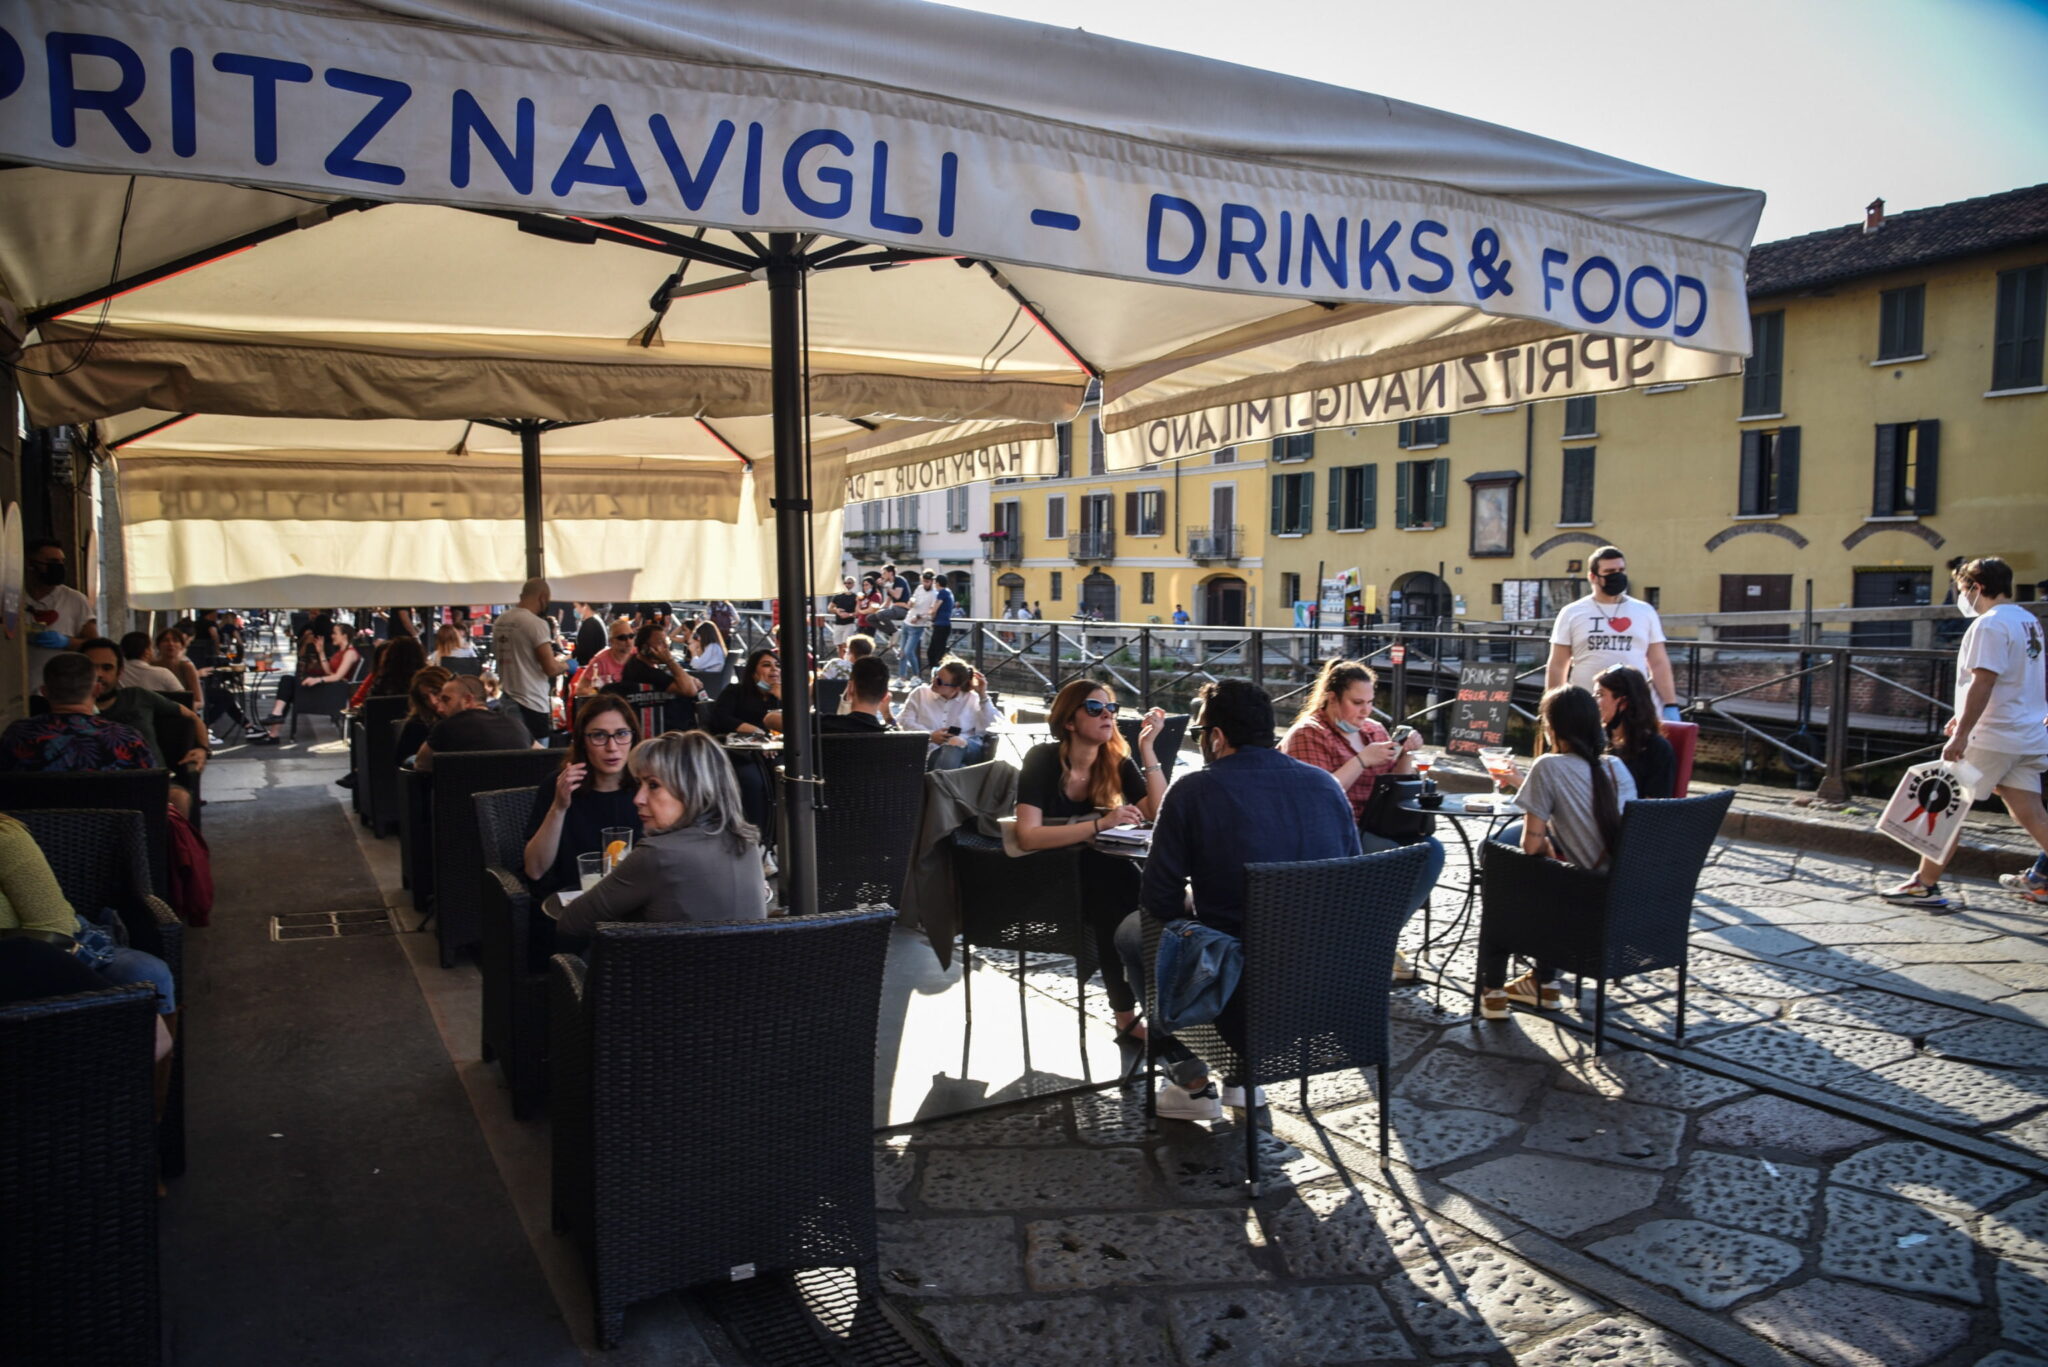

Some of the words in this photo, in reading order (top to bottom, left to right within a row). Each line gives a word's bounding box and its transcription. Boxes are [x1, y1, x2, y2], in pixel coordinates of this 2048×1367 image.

[450, 88, 958, 238] NAVIGLI
[1542, 247, 1708, 337] FOOD
[1588, 616, 1605, 633] I
[1587, 635, 1633, 651] SPRITZ
